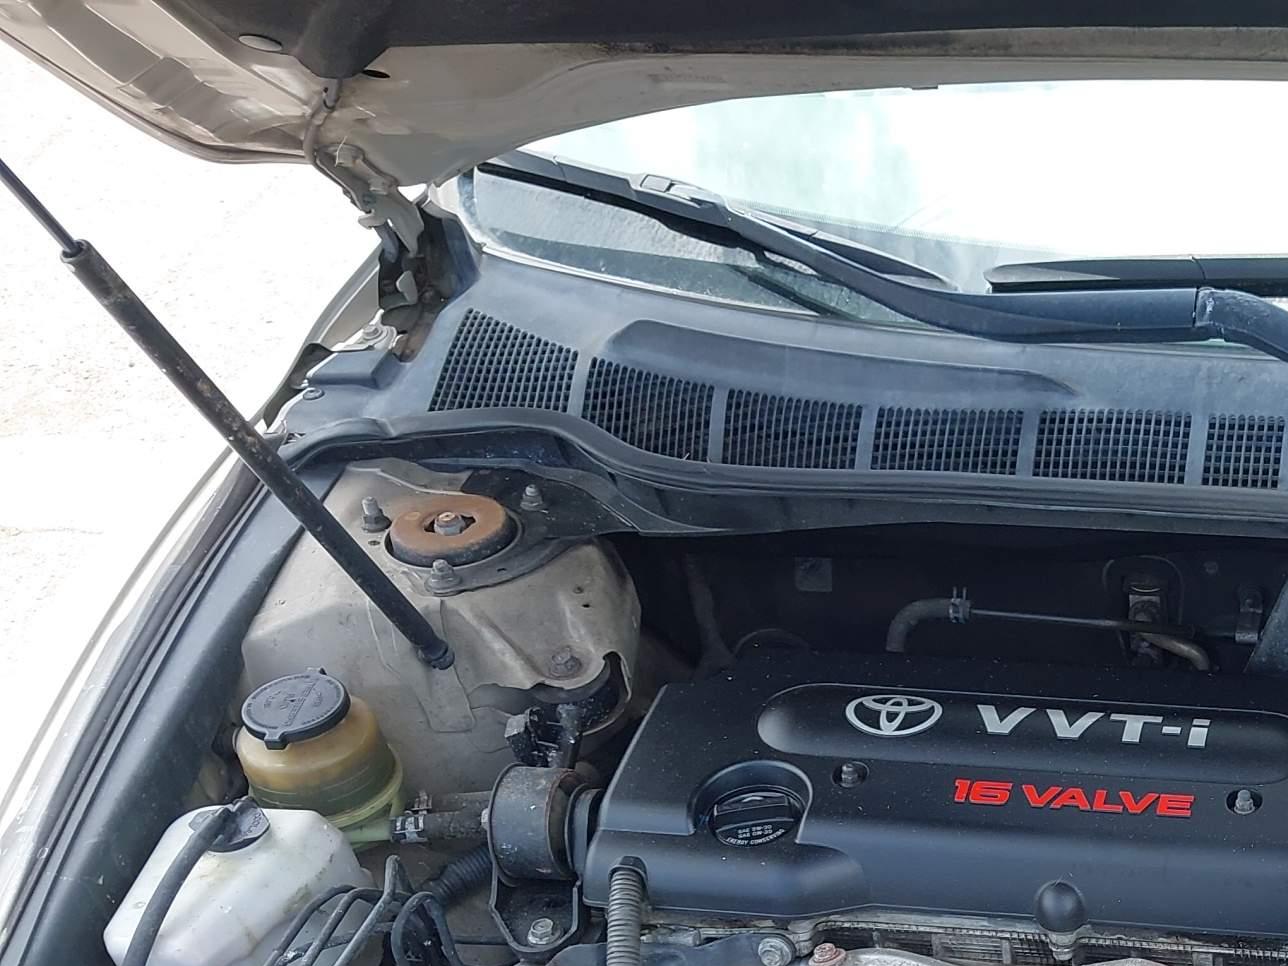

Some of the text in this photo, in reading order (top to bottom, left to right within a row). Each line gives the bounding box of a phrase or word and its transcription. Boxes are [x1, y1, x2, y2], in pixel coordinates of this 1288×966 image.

[976, 704, 1211, 748] VVT-i
[953, 779, 1195, 818] 16 VALVE
